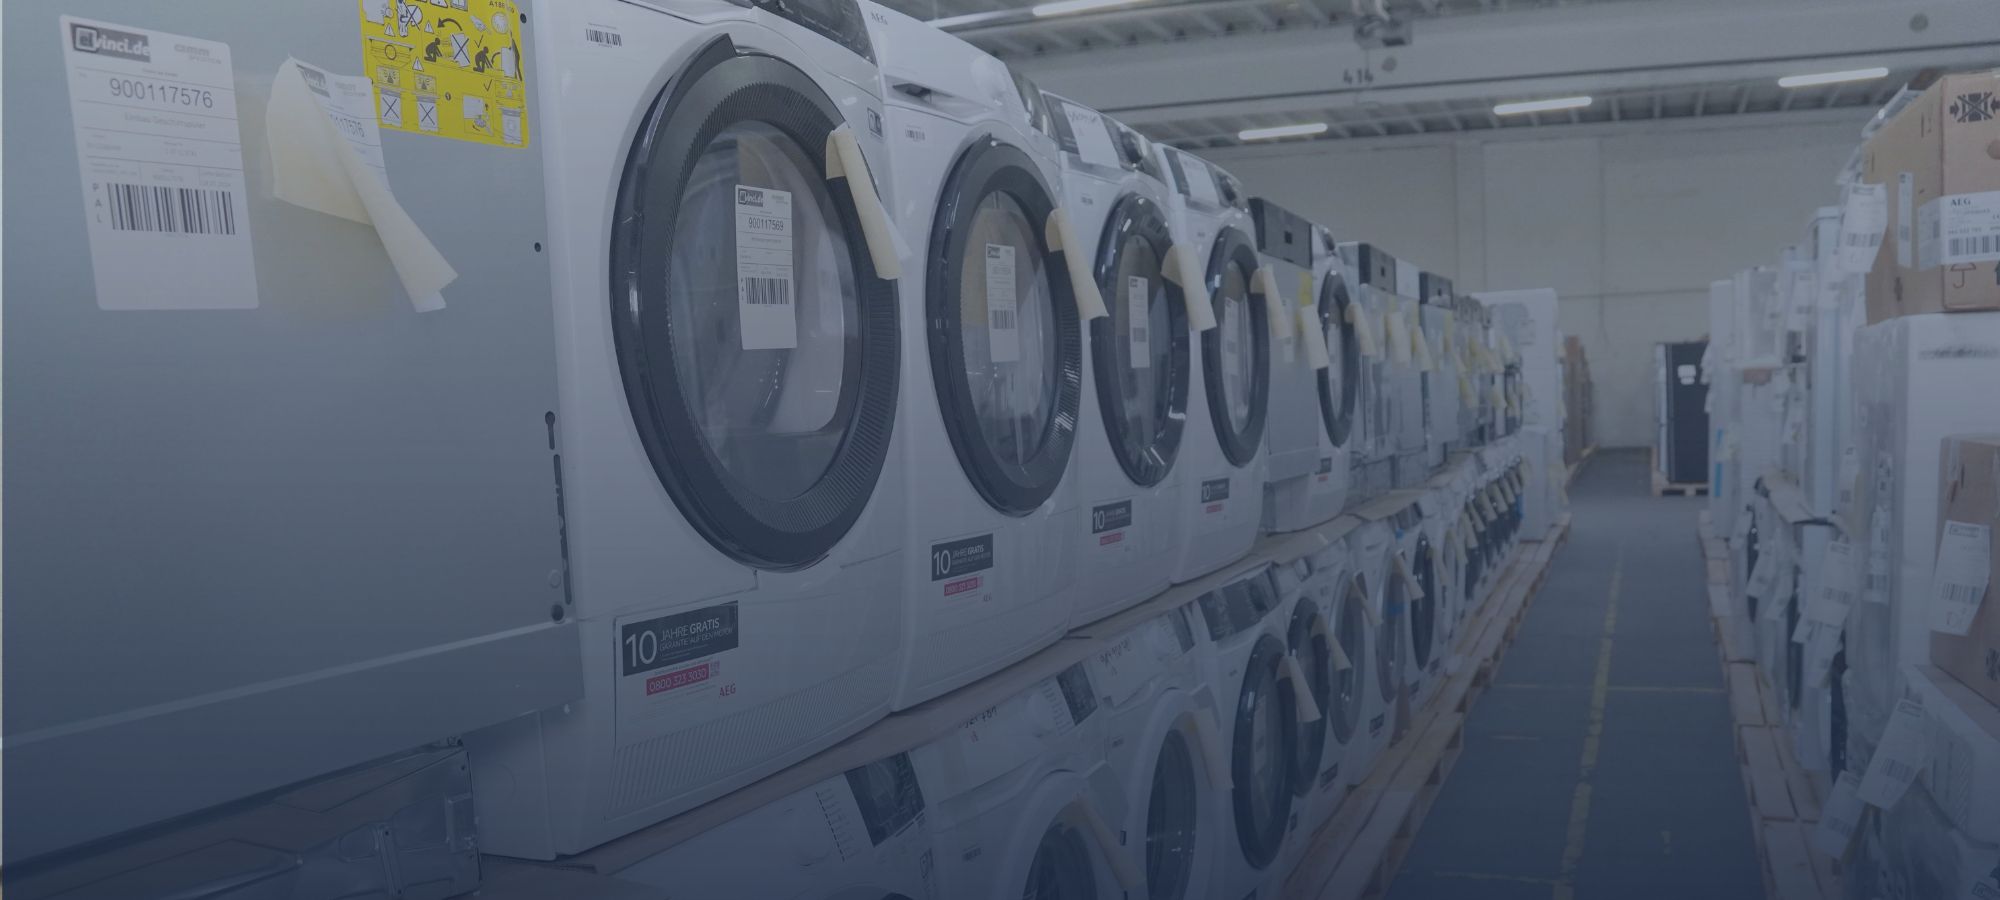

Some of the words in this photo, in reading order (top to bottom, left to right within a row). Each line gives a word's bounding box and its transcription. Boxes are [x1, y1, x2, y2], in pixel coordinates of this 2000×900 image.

[1343, 68, 1375, 85] 414
[110, 78, 213, 109] 900117576
[1093, 510, 1105, 530] 10
[933, 549, 951, 575] 10
[626, 630, 658, 668] 10
[661, 625, 689, 642] JAHRE
[690, 617, 720, 634] GRATIS
[649, 678, 672, 692] 0800
[719, 683, 737, 697] AEG
